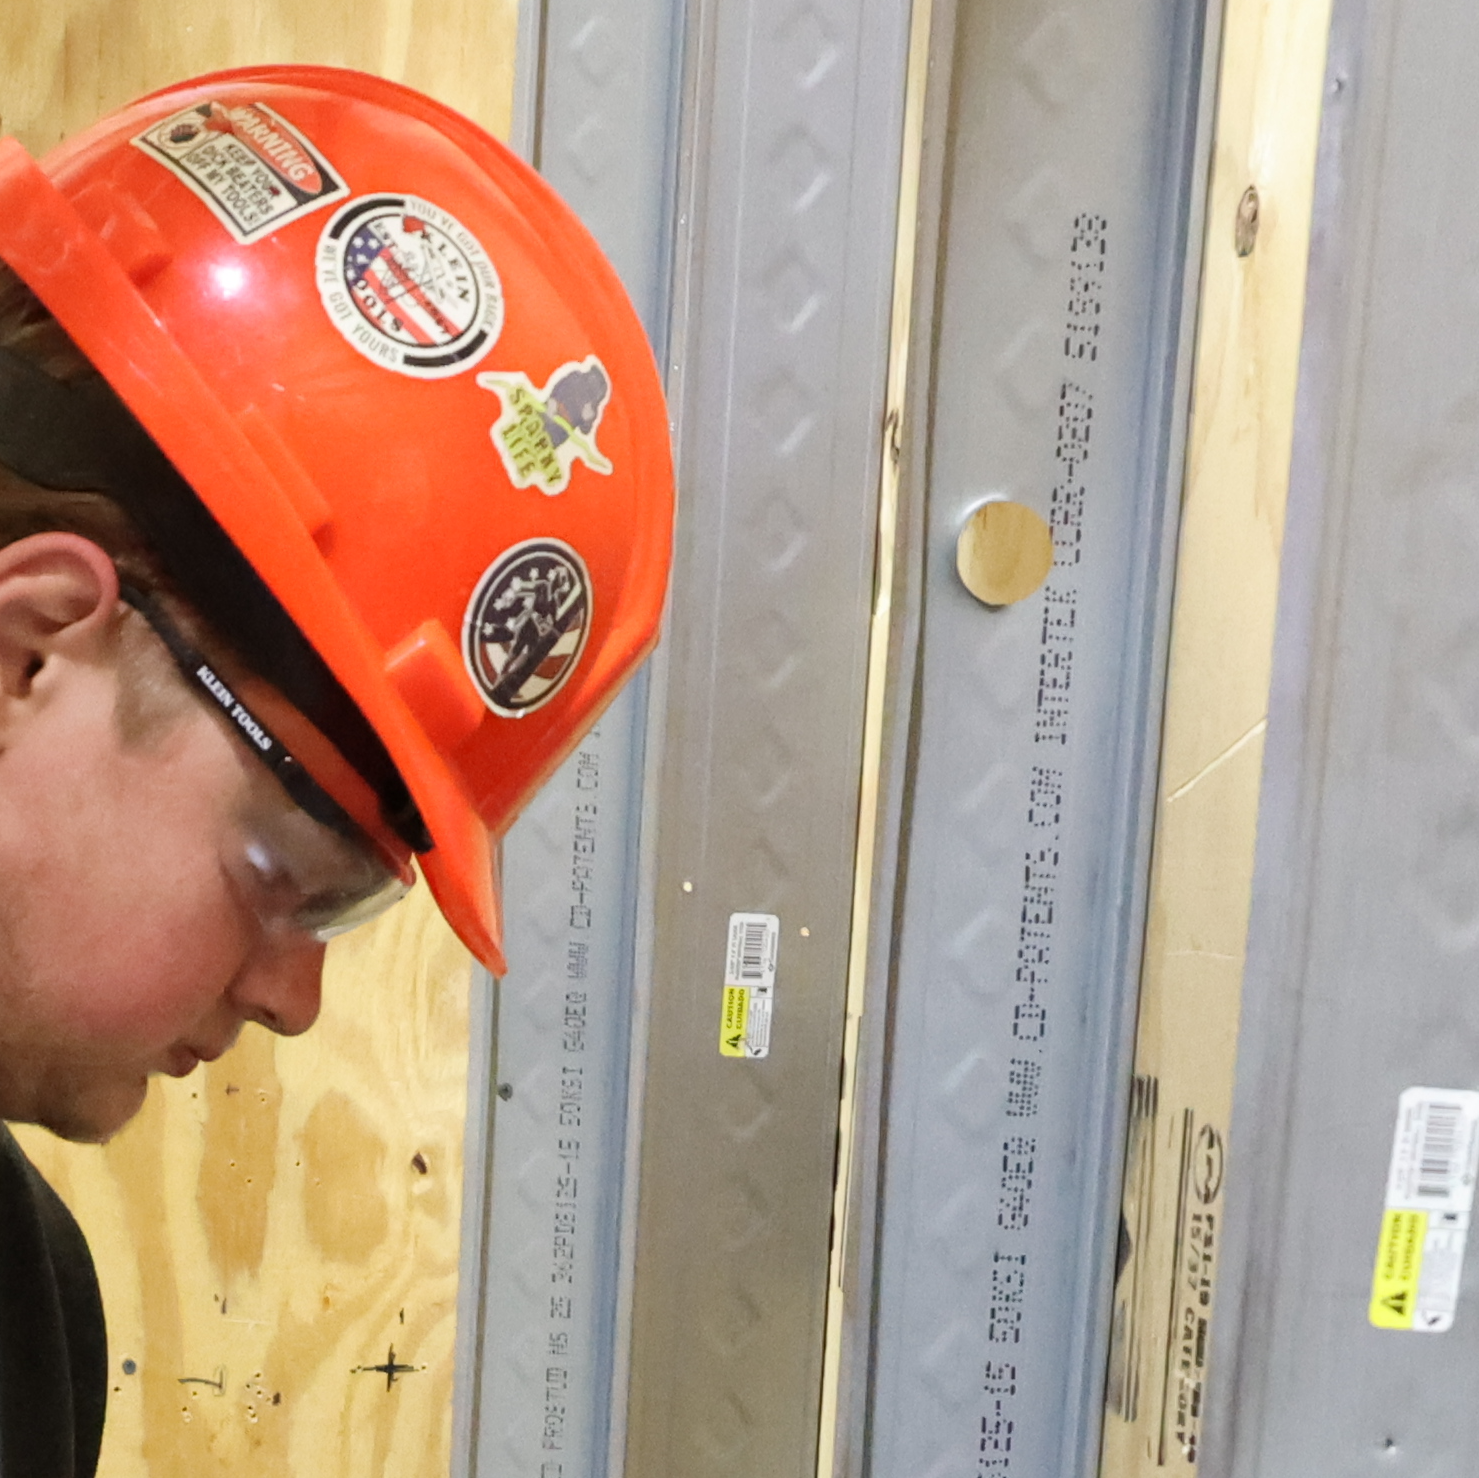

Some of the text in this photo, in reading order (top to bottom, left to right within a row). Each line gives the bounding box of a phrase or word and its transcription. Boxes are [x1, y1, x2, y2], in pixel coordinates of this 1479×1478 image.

[229, 106, 311, 180] WARNING
[351, 322, 401, 364] YOURS
[502, 423, 536, 477] LIFE
[196, 665, 272, 750] KLEIN TOOLS
[988, 1251, 1026, 1344] 50KSI
[1034, 586, 1077, 744] INTERTEK
[542, 1366, 568, 1450] PROSTUD
[558, 1066, 583, 1126] 50KSI
